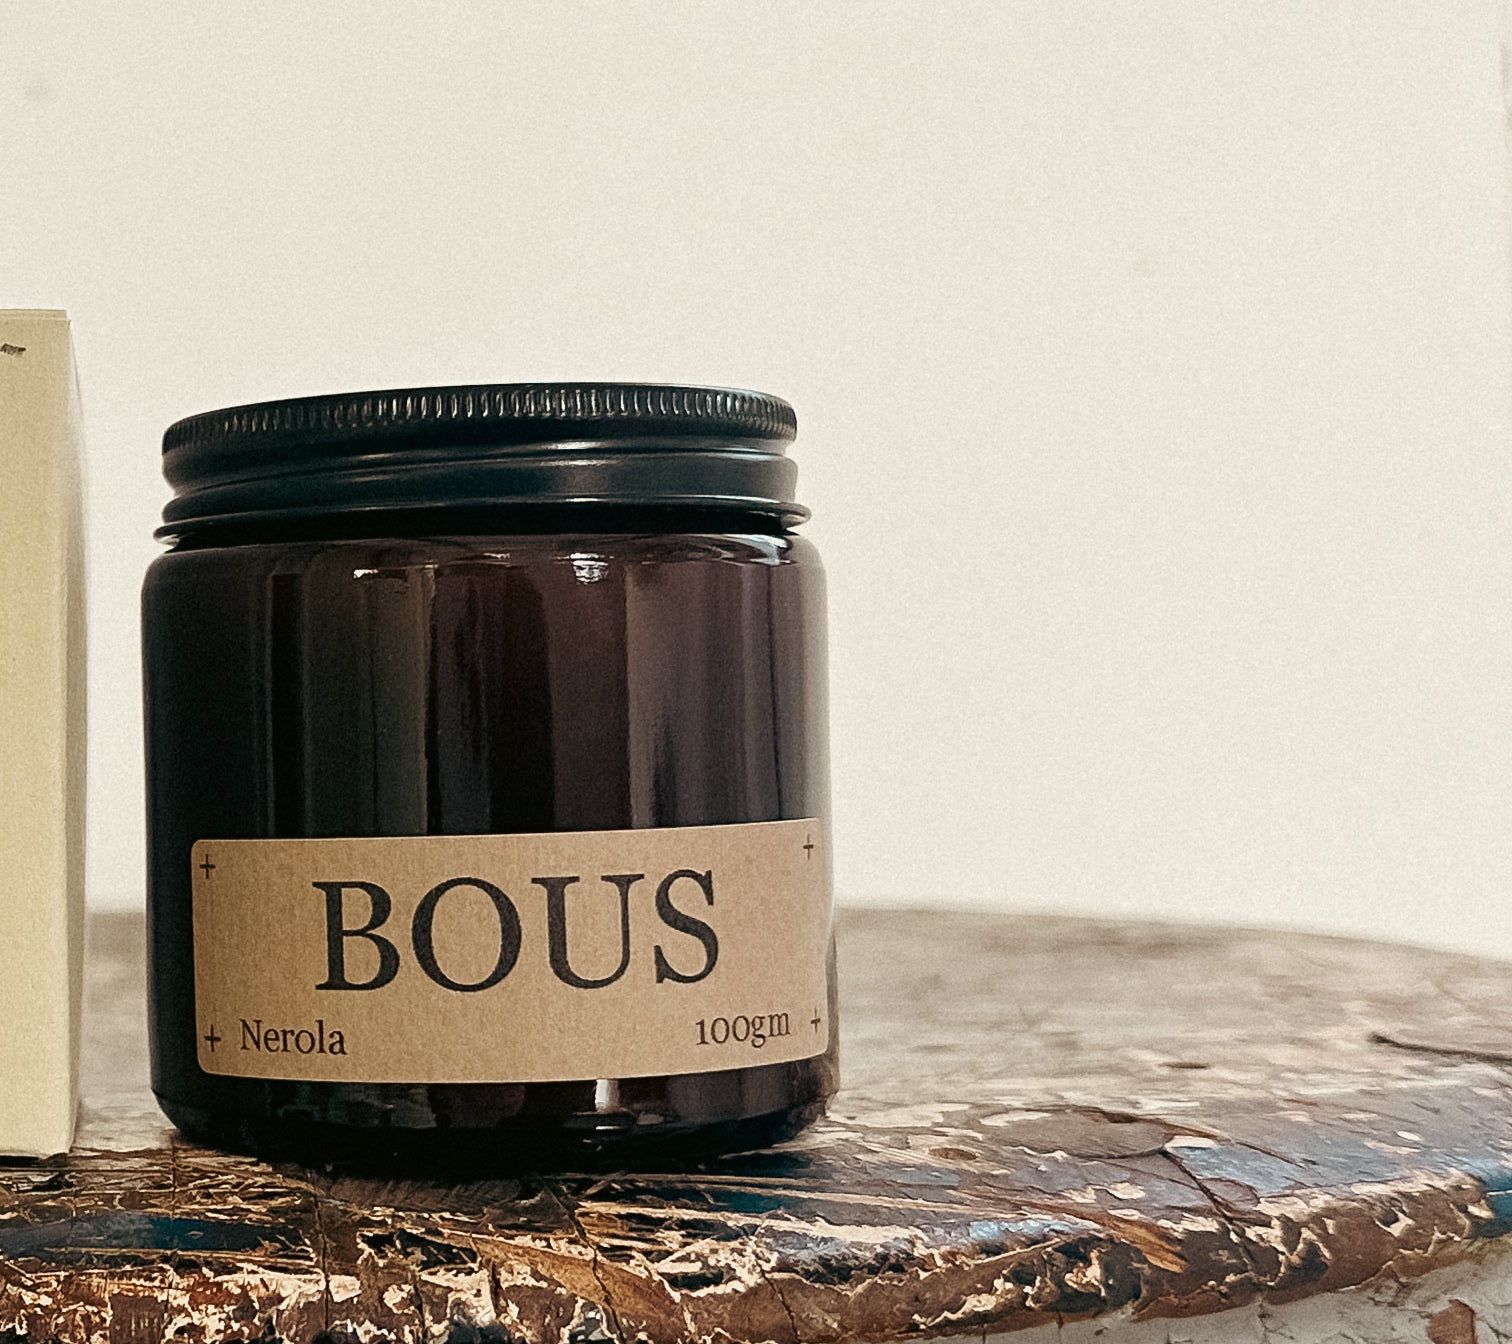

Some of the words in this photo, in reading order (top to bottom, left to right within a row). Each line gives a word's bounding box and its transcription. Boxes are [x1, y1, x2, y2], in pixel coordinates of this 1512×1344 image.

[311, 867, 720, 994] BOUS
[238, 1018, 348, 1057] Nerola
[694, 1007, 792, 1049] 100gm
